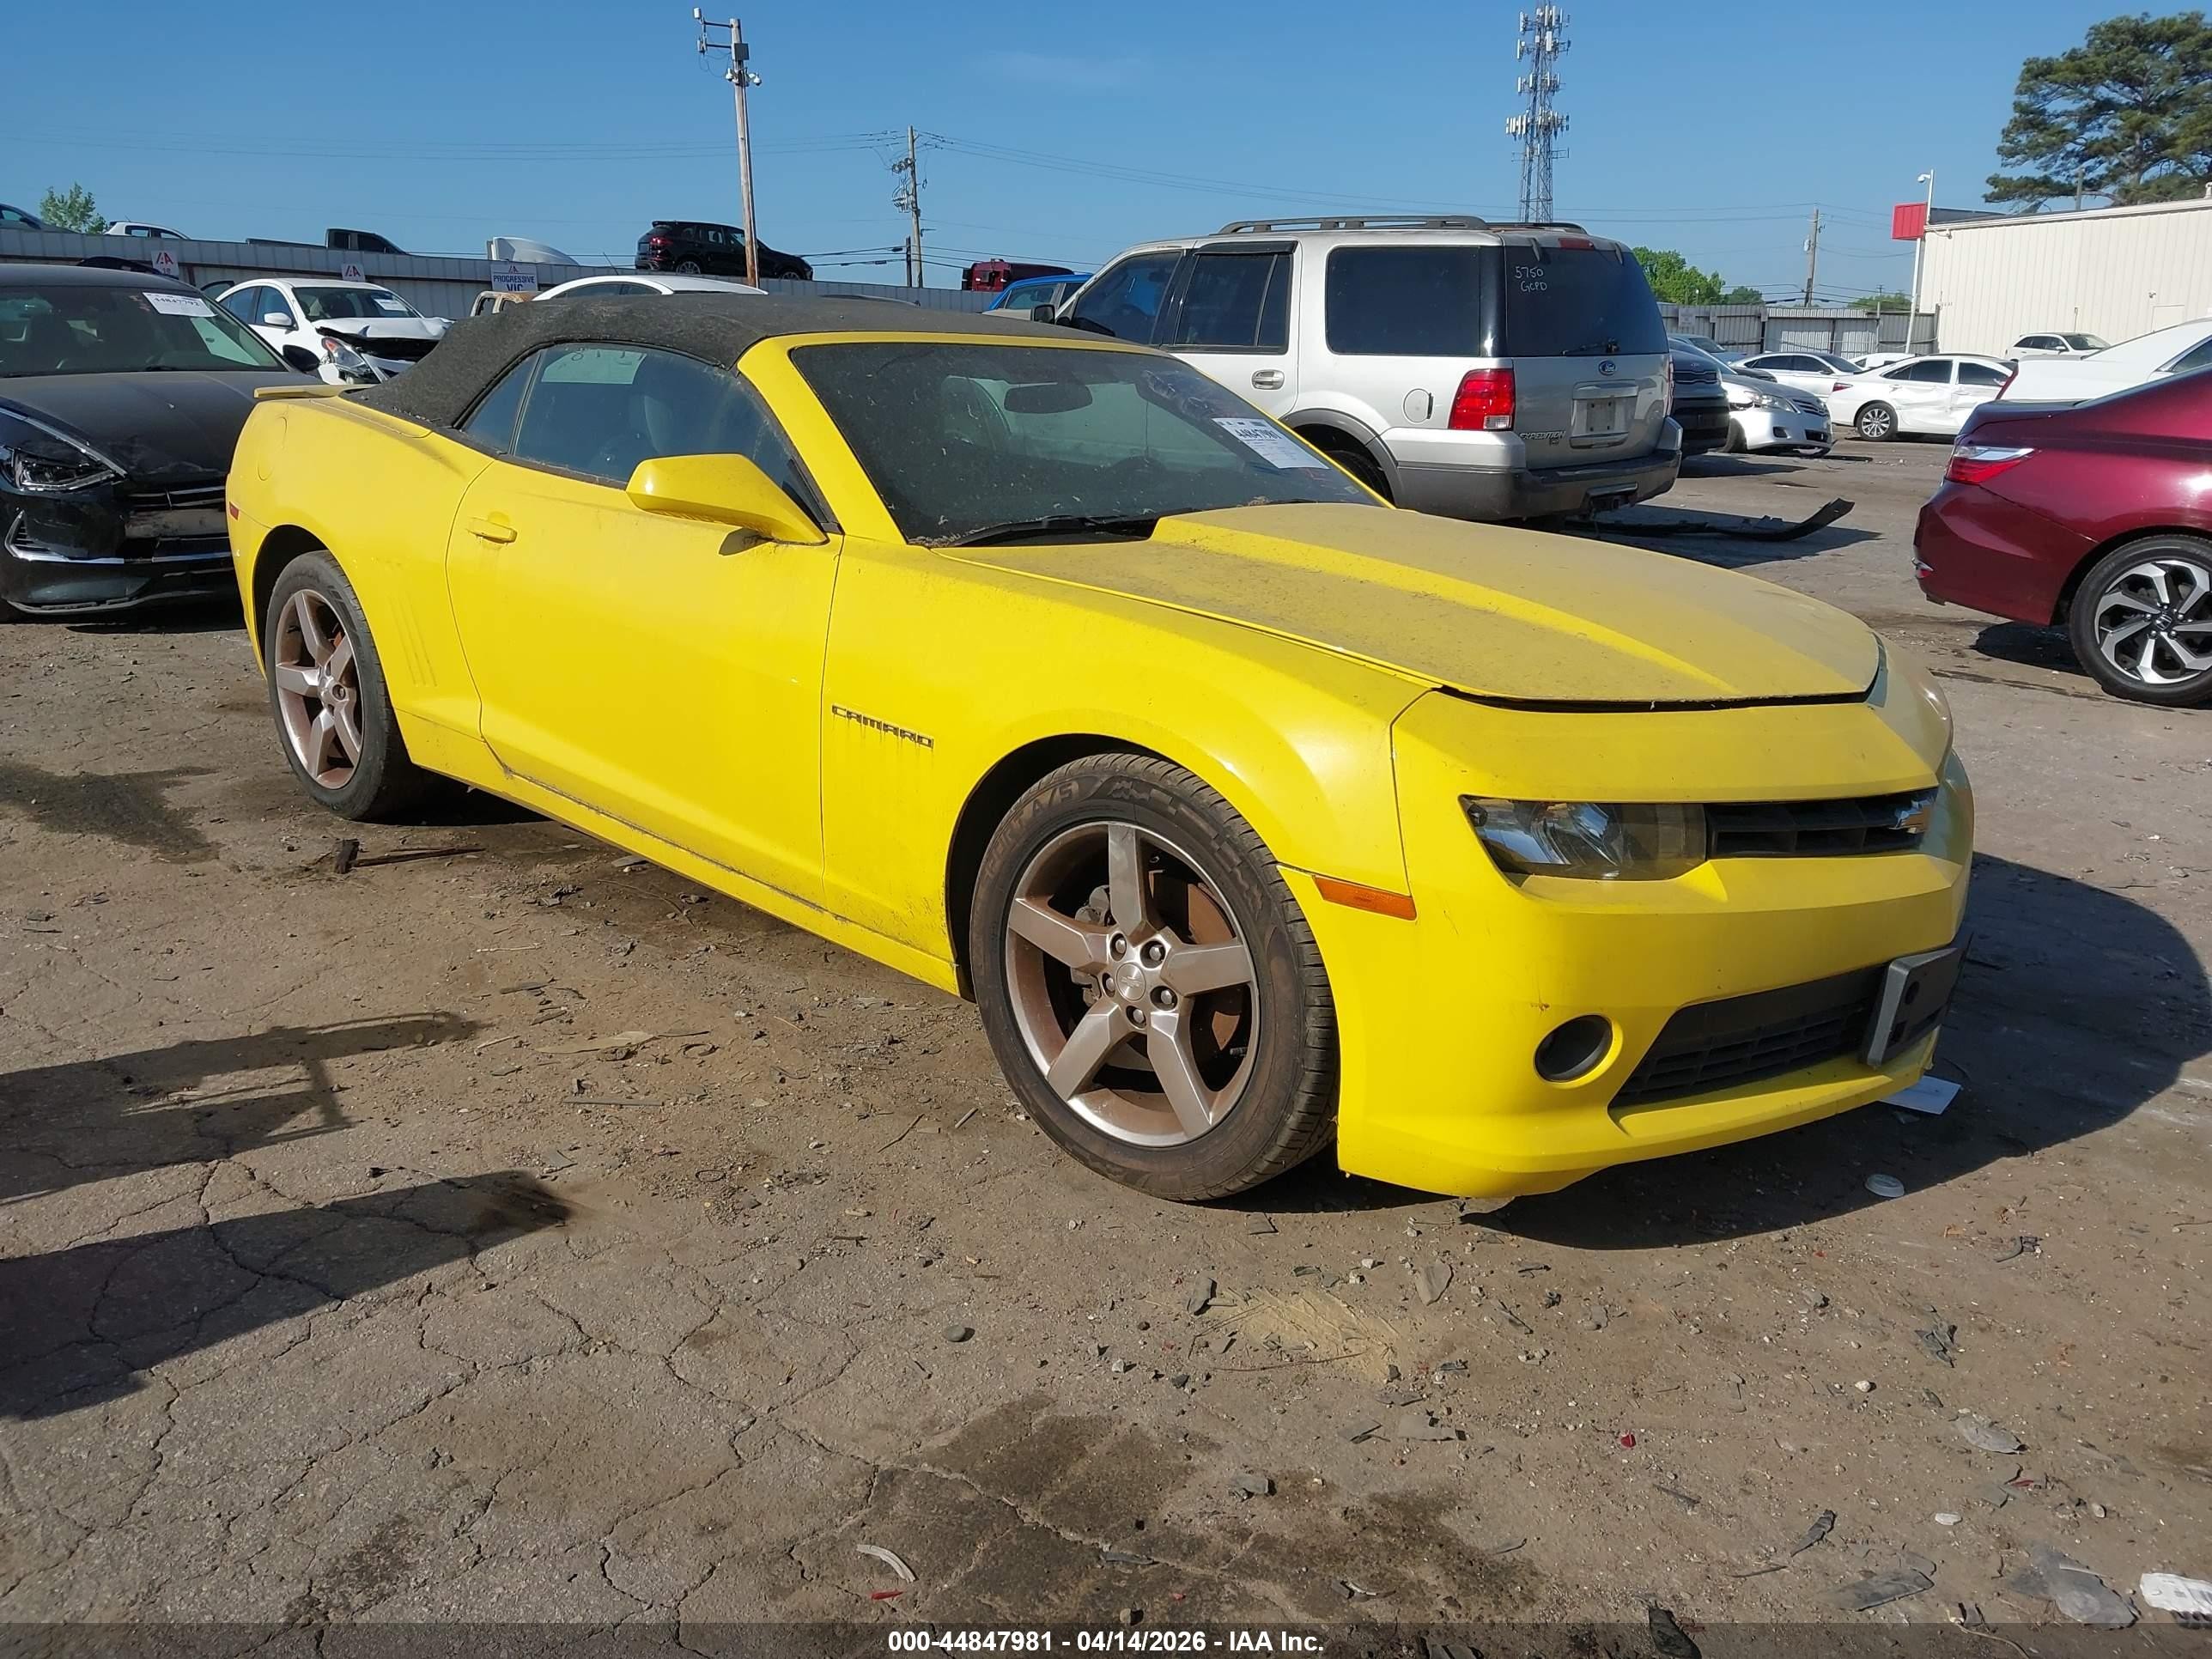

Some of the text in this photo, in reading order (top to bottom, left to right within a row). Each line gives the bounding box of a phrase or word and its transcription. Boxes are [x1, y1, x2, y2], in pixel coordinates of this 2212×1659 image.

[1515, 265, 1544, 279] 5750
[494, 275, 536, 283] PROGRESSIVE
[1519, 430, 1566, 441] EXPEDITION
[831, 704, 934, 750] CAMARO
